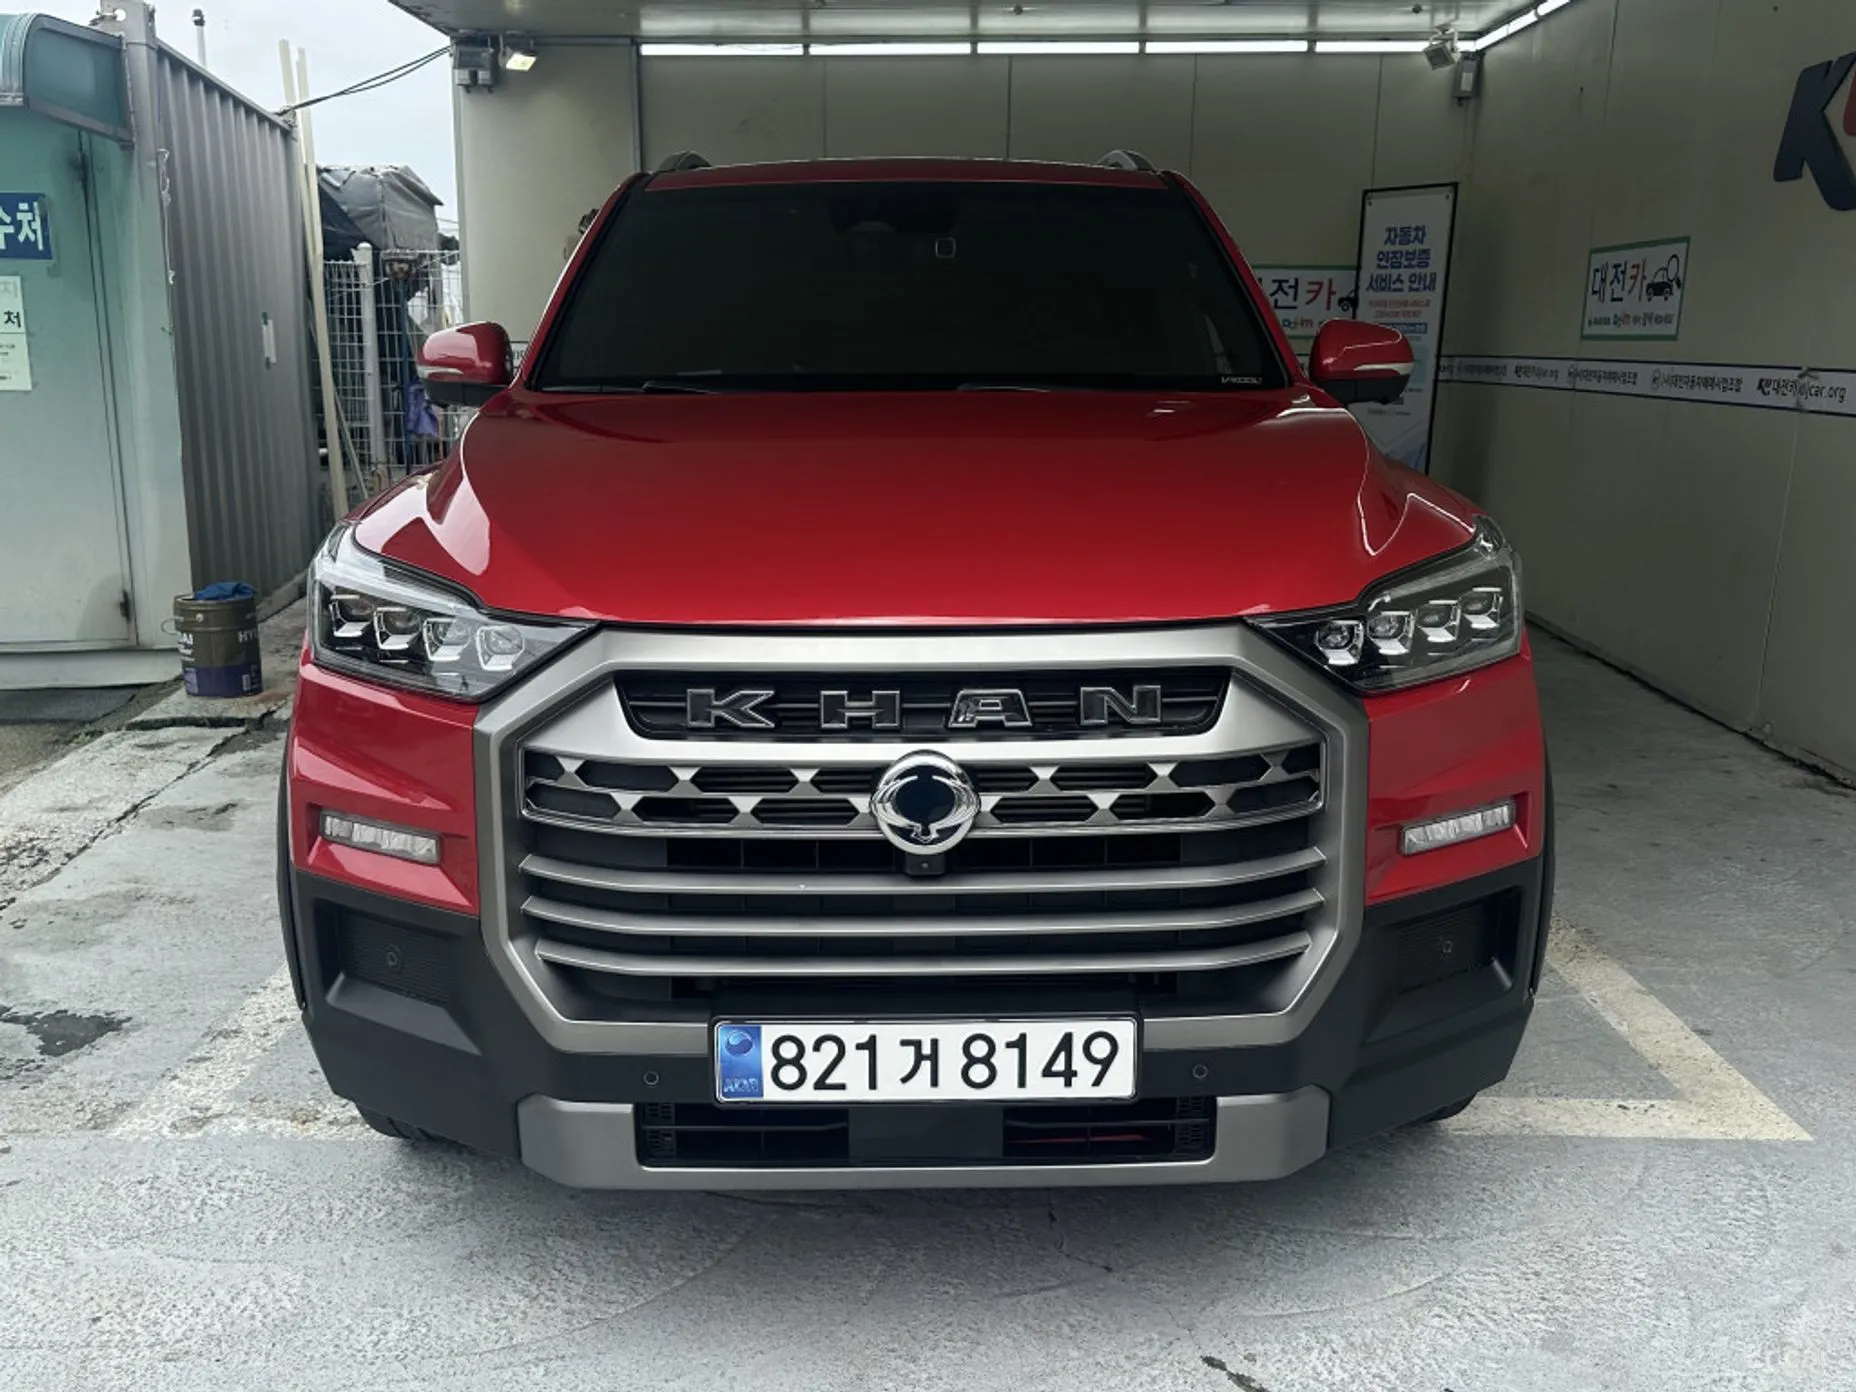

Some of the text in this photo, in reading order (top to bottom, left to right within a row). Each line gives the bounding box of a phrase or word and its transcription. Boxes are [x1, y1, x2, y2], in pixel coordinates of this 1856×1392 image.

[1384, 225, 1426, 246] 자동차
[1257, 277, 1336, 311] 전카
[1366, 271, 1437, 293] 서비스 안내
[1592, 257, 1647, 303] 대전카
[686, 685, 1162, 729] KHAN
[770, 1030, 1119, 1091] 821거 8149
